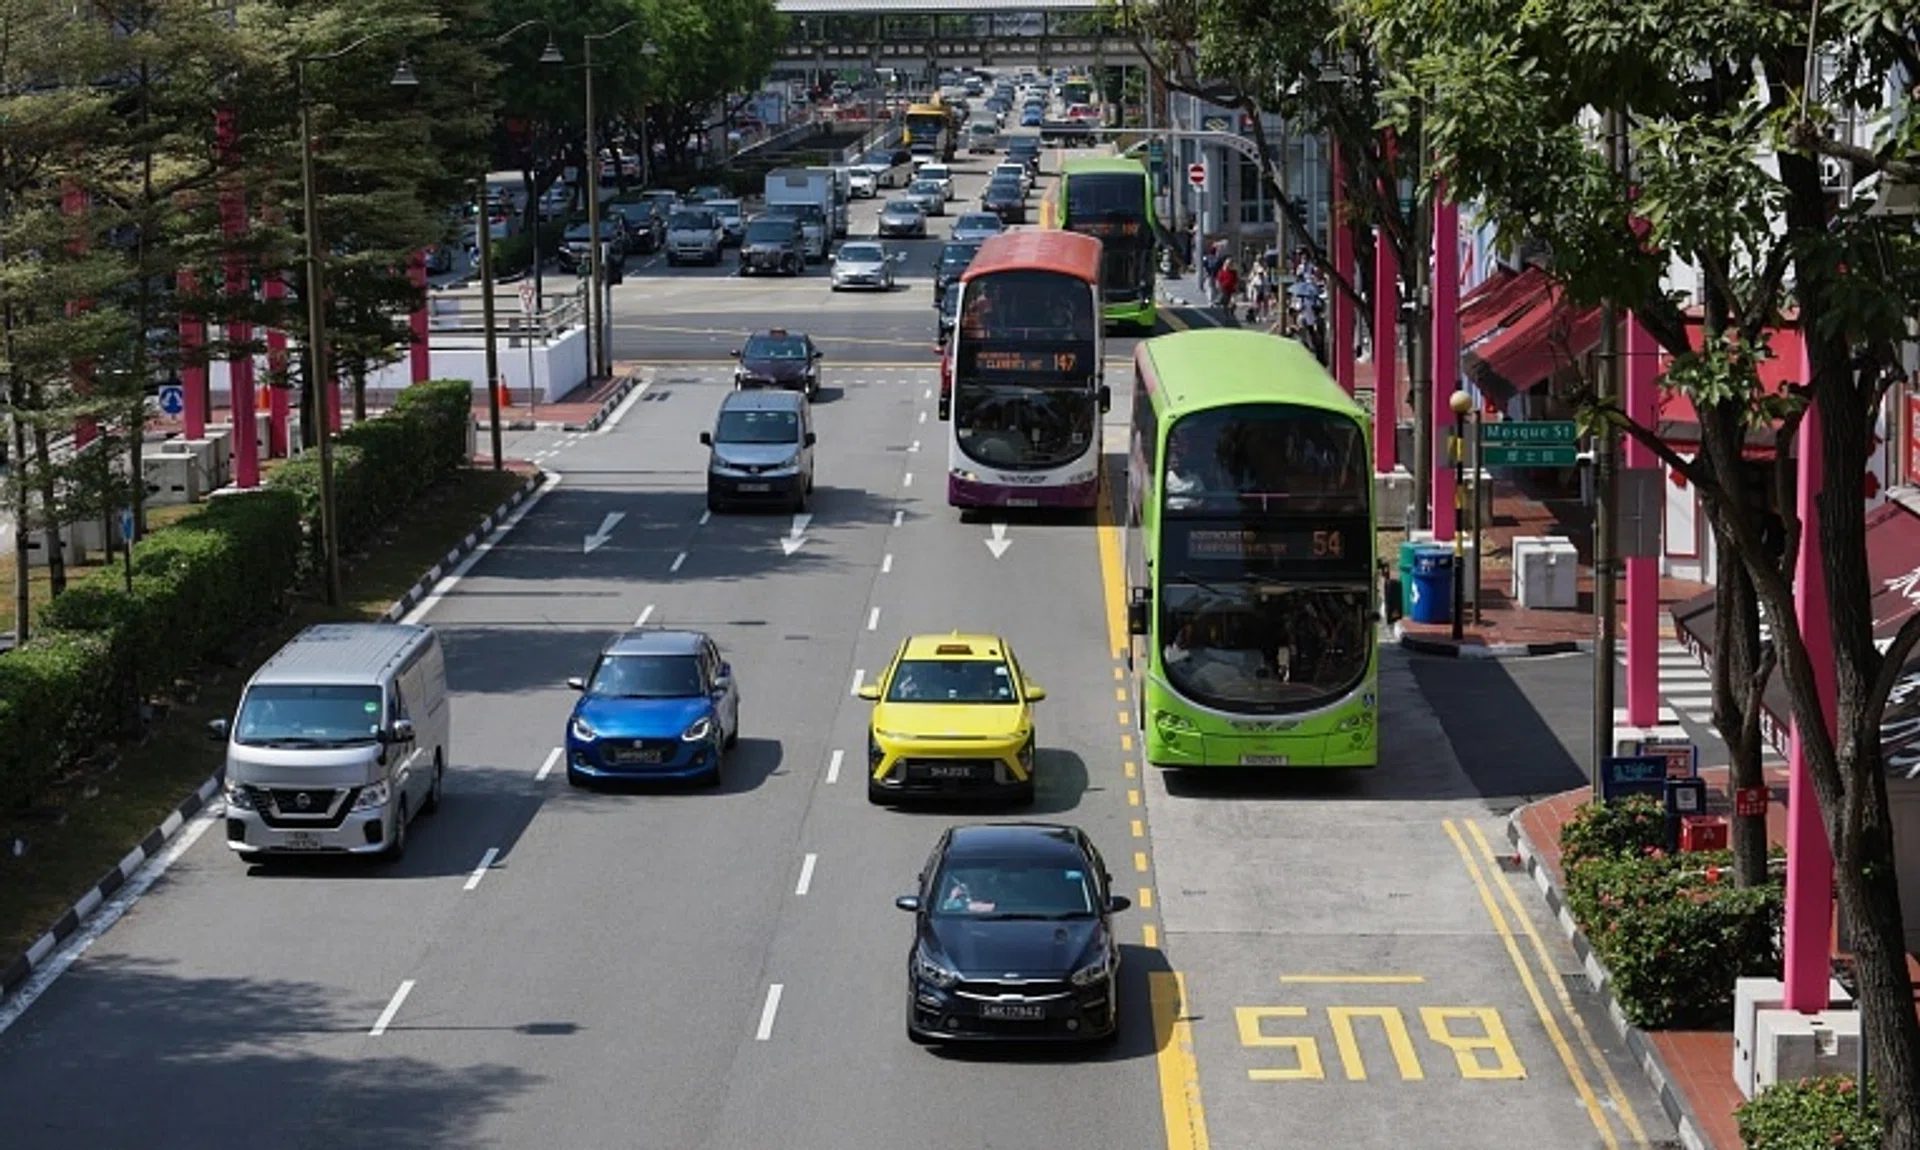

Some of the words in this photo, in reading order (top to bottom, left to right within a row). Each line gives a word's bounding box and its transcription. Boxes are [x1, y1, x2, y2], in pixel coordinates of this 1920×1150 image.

[1054, 353, 1077, 371] 147
[1487, 425, 1549, 440] Mosque
[1553, 425, 1570, 439] St
[1312, 531, 1341, 557] 54
[1235, 1006, 1528, 1080] BUS
